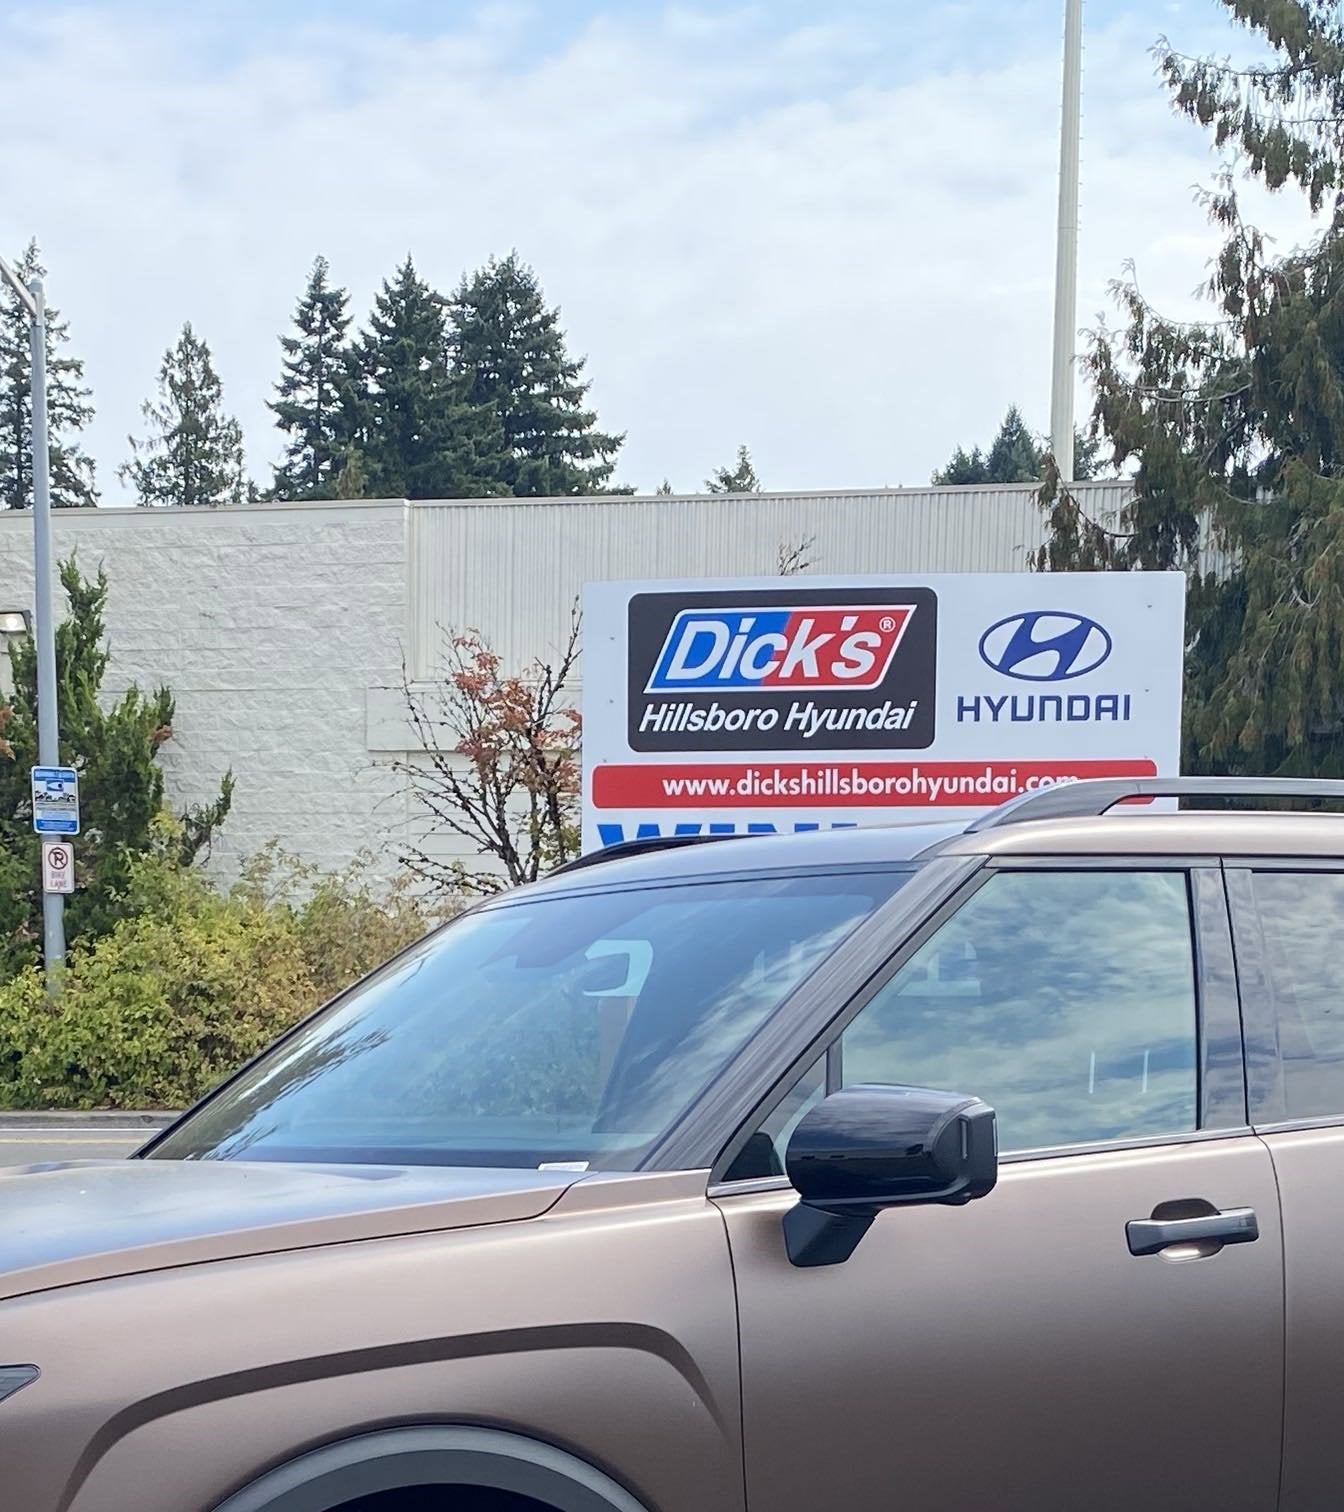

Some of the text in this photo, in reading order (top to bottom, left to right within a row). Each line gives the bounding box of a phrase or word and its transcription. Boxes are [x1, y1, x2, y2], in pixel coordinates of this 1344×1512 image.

[638, 701, 918, 738] Hillsboro Hyundai
[957, 694, 1131, 722] HYUNDAI
